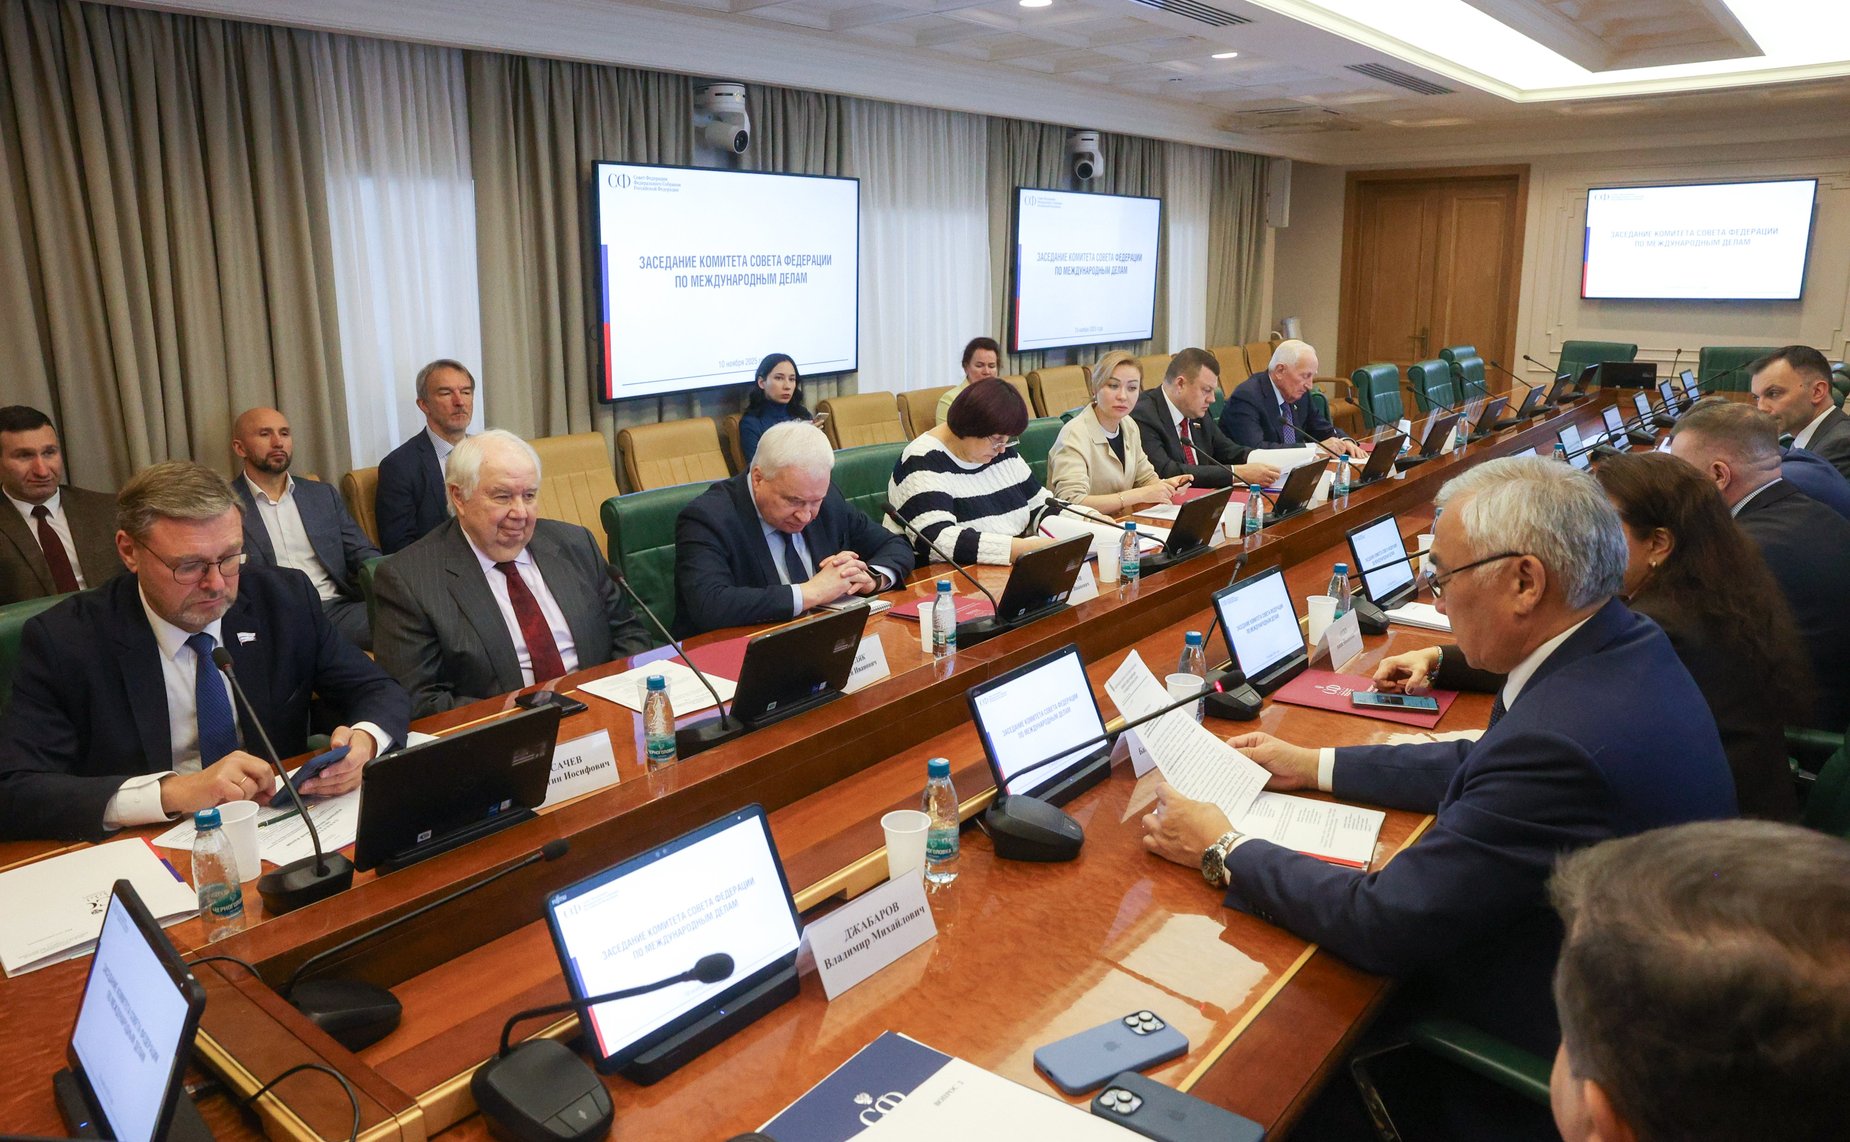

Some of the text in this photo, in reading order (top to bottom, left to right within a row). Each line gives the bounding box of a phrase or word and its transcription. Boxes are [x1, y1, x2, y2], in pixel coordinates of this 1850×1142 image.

[607, 173, 631, 189] СФ
[1654, 230, 1694, 238] КОМИТЕТА
[1696, 229, 1726, 237] СОВЕТА
[1728, 227, 1779, 236] ФЕДЕРАЦИИ
[1646, 239, 1720, 247] МЕЖДУНАРОДНЫМ
[1722, 238, 1751, 247] ДЕЛАМ
[639, 254, 832, 270] ЗАСЕДАНИЕ КОМИТЕТА СОВЕТА ФЕДЕРАЦИИ
[1036, 252, 1143, 262] ЗАСЕДАНИЕ КОМИТЕТА СОВЕТА ФЕДЕРАЦИИ
[1063, 266, 1110, 276] МЕЖДУНАРОДНЫМ
[1111, 266, 1128, 275] ДЕЛАМ
[675, 272, 808, 288] ПО МЕЖДУНАРОДНЫМ ДЕЛАМ
[563, 760, 611, 780] Иосифович
[601, 876, 755, 960] ЗАСЕДАНИЕ КОМИТЕТА СОВЕТА ФЕДЕРАЦИИ
[844, 901, 900, 942] ДЖАБАРОВ
[632, 899, 739, 960] ПО МЕЖДУНАРОДНЫМ ДЕЛАМ
[823, 905, 926, 970] Владимир Михайлович
